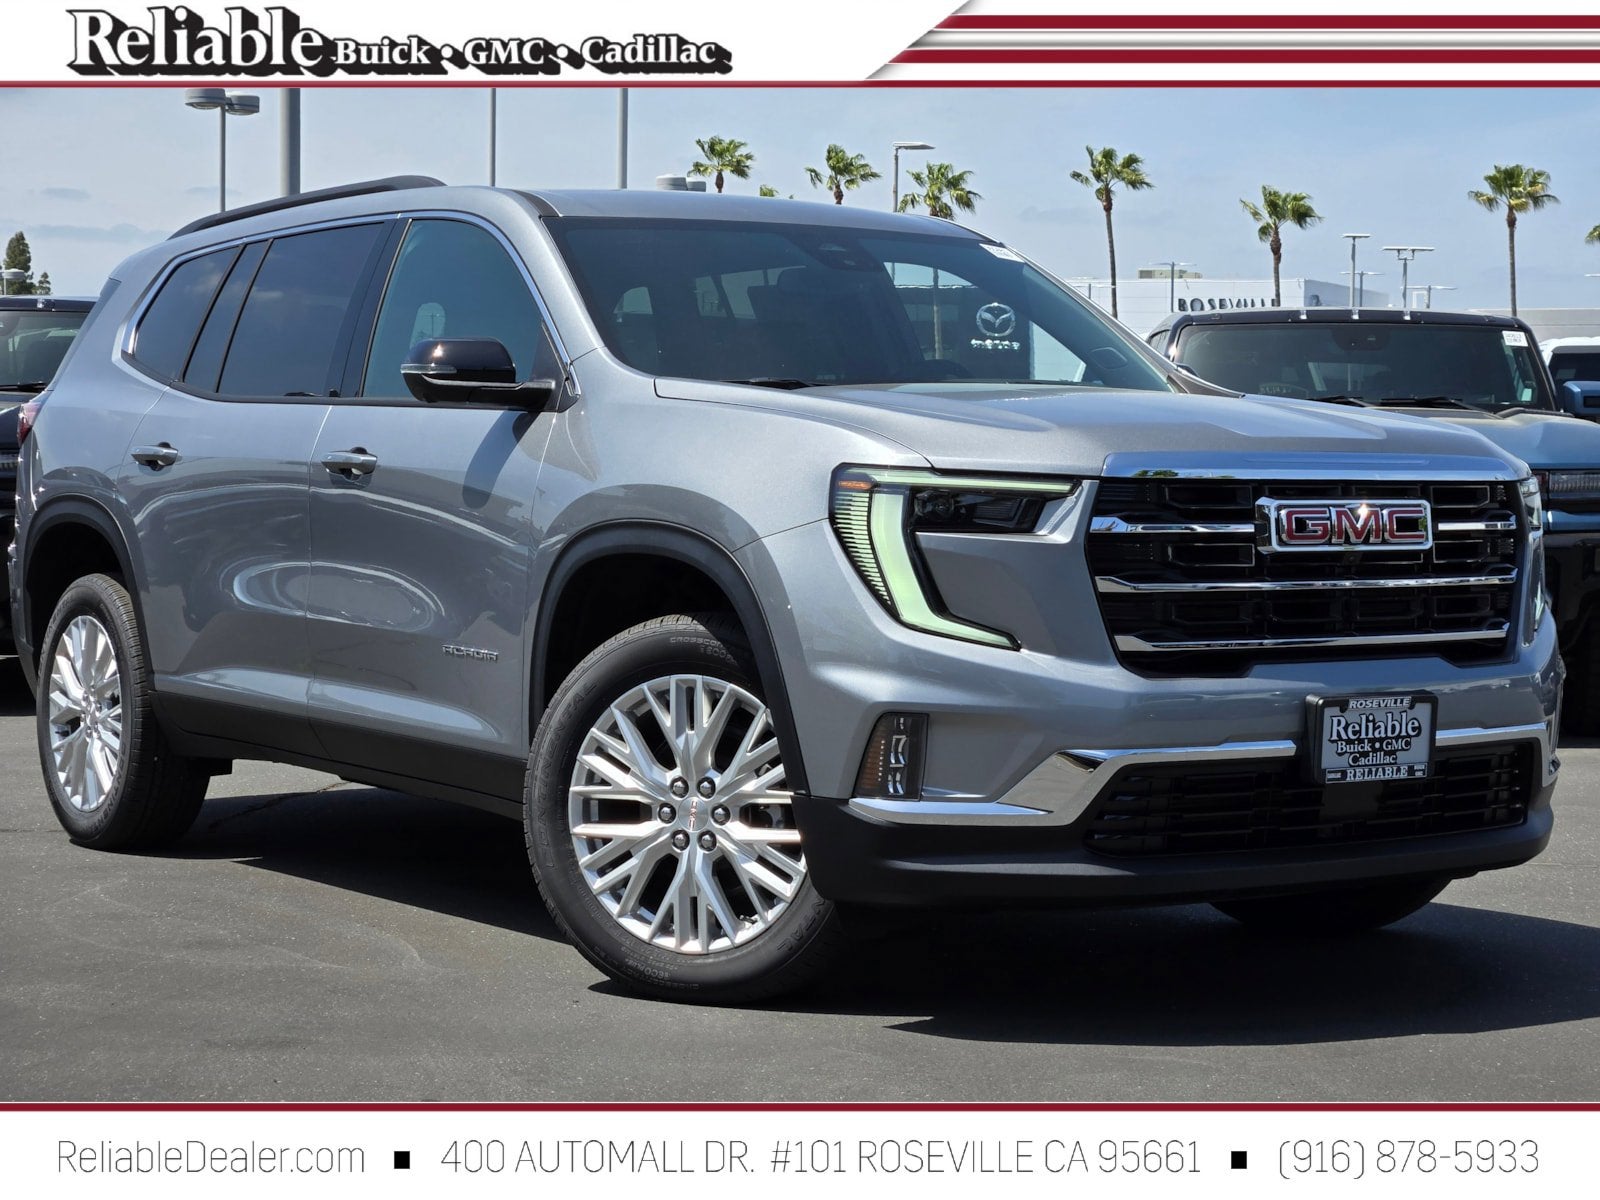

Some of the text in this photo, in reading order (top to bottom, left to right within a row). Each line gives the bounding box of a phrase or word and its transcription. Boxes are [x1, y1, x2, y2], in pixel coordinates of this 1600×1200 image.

[1278, 507, 1427, 544] GMC
[442, 644, 499, 661] ACADIA
[1349, 698, 1410, 709] ROSEVILLE
[1330, 711, 1420, 741] Reliable
[1337, 738, 1411, 753] Buick GMC
[1348, 752, 1397, 766] Cadillac
[1346, 765, 1409, 781] RELIABLE
